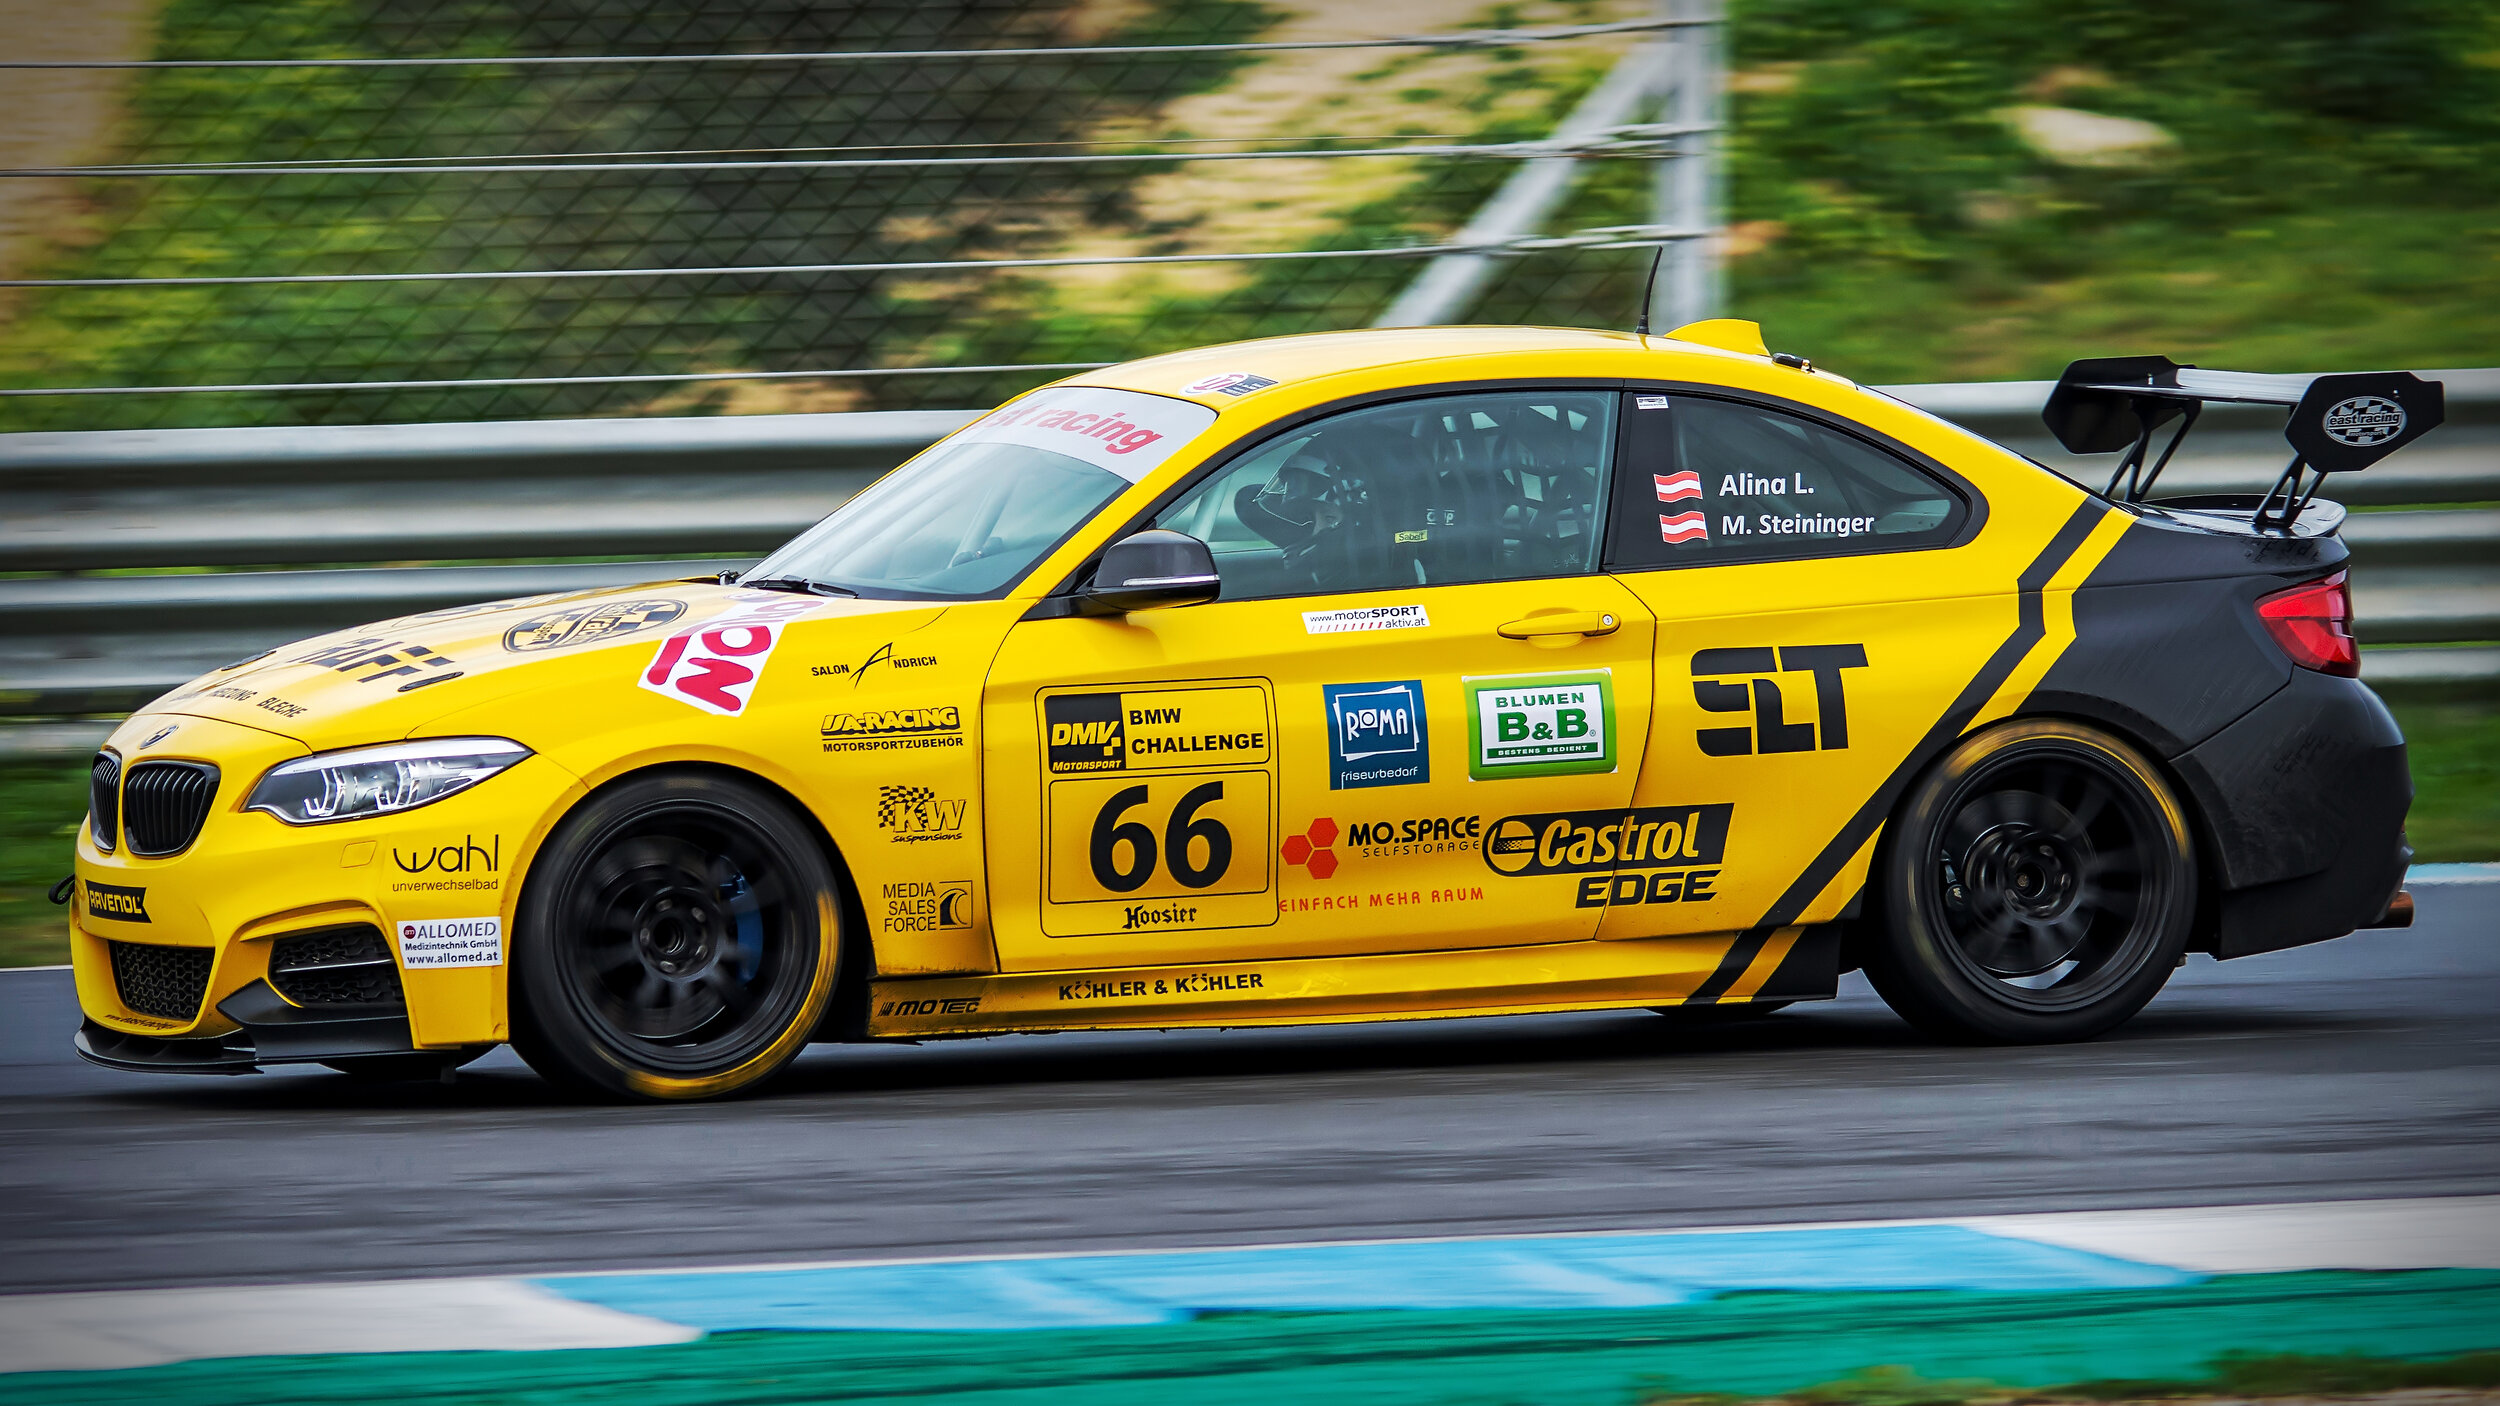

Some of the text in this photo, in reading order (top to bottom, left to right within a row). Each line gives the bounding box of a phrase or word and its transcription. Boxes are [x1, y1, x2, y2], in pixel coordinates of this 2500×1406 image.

[2329, 411, 2401, 425] east racing
[1022, 409, 1164, 455] racing
[1719, 472, 1815, 497] Alina L.
[1721, 512, 1875, 538] M. Steininger
[1309, 606, 1419, 622] www.motorSPORT
[1385, 617, 1426, 629] aktiv.at
[811, 664, 850, 676] SALON
[256, 697, 308, 718] BLECHE
[1495, 692, 1585, 708] BLUMEN
[1129, 708, 1181, 726] BMW
[1345, 708, 1408, 741] ROMA
[1051, 720, 1121, 747] DMV
[1131, 733, 1264, 755] CHALLENGE
[823, 736, 963, 753] MOTORSPORTZUBEHÖR
[1498, 745, 1588, 756] BESTENS BEDIENT
[1341, 766, 1418, 790] friseurbedarf
[893, 799, 967, 832] KW
[890, 832, 963, 844] suspensions
[1089, 781, 1232, 893] 66
[1348, 815, 1480, 847] MO.SPACE
[1538, 812, 1700, 868] Castrol
[393, 834, 499, 873] wahl
[1362, 840, 1480, 858] SELFSTORAGE
[392, 879, 498, 892] unverwechselbad
[883, 882, 936, 899] MEDIA
[1575, 869, 1722, 909] EDGE
[89, 889, 143, 914] RAVENOL
[888, 899, 936, 916] SALES
[1279, 887, 1484, 912] EINFACH MEHR RAUM
[884, 916, 936, 933] FORCE
[1121, 903, 1197, 929] Hoosier
[417, 922, 497, 939] ALLOMED
[405, 939, 498, 951] Medizintechnik GmbH
[407, 951, 498, 964] www.allomed.at
[1058, 973, 1264, 1000] KÖHLER & KÖHLER
